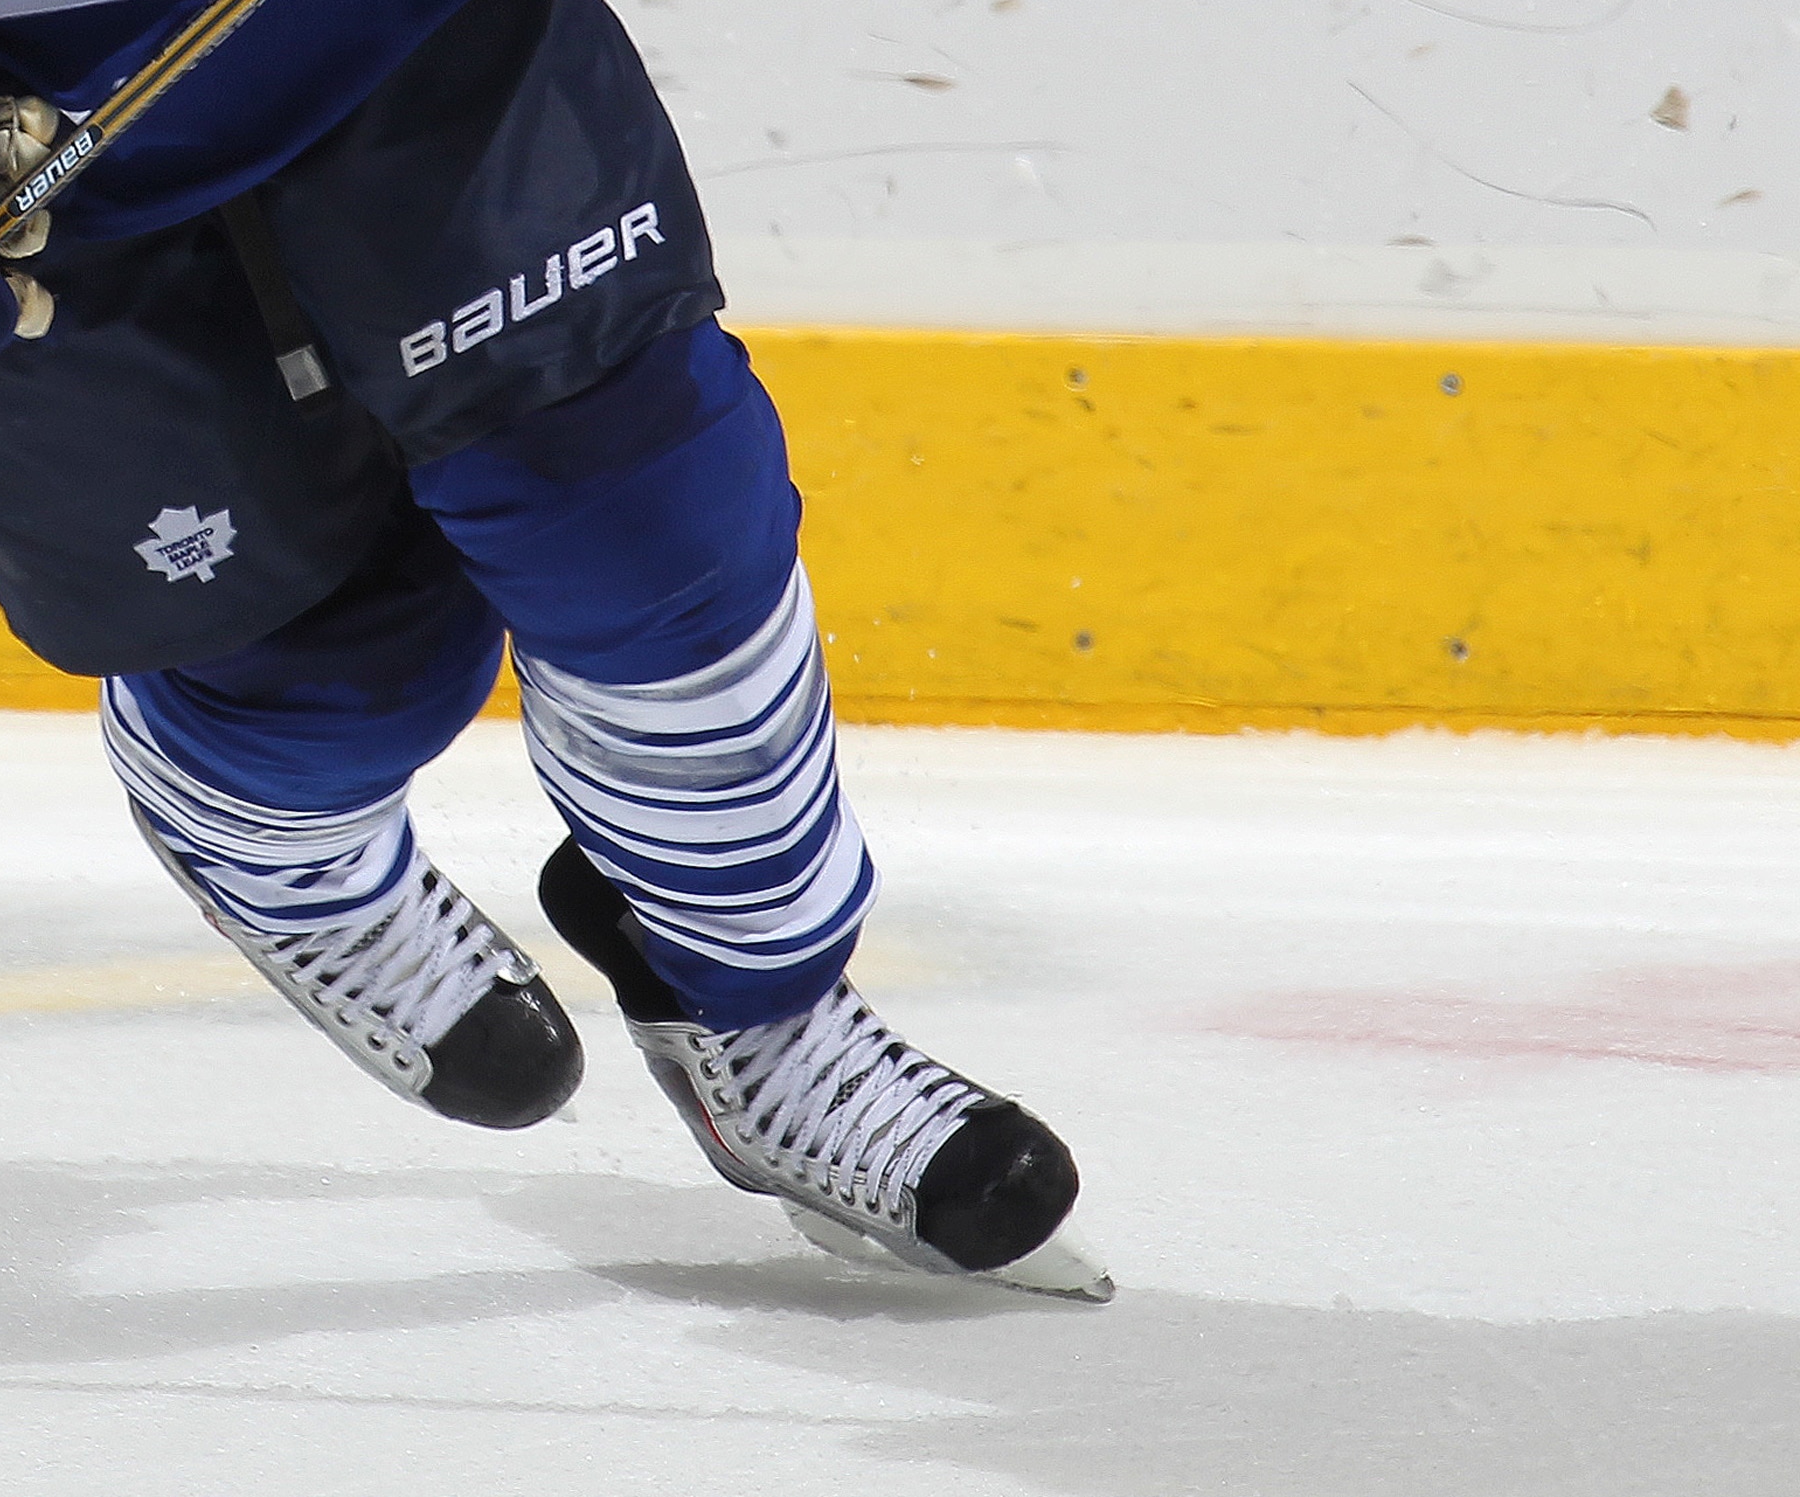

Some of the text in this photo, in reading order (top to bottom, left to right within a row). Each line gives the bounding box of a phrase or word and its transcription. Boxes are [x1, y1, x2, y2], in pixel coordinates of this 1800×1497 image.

[14, 129, 95, 212] BAUER
[398, 200, 667, 379] BAUER
[155, 526, 214, 557] TORONTO
[175, 550, 213, 572] LEAFS
